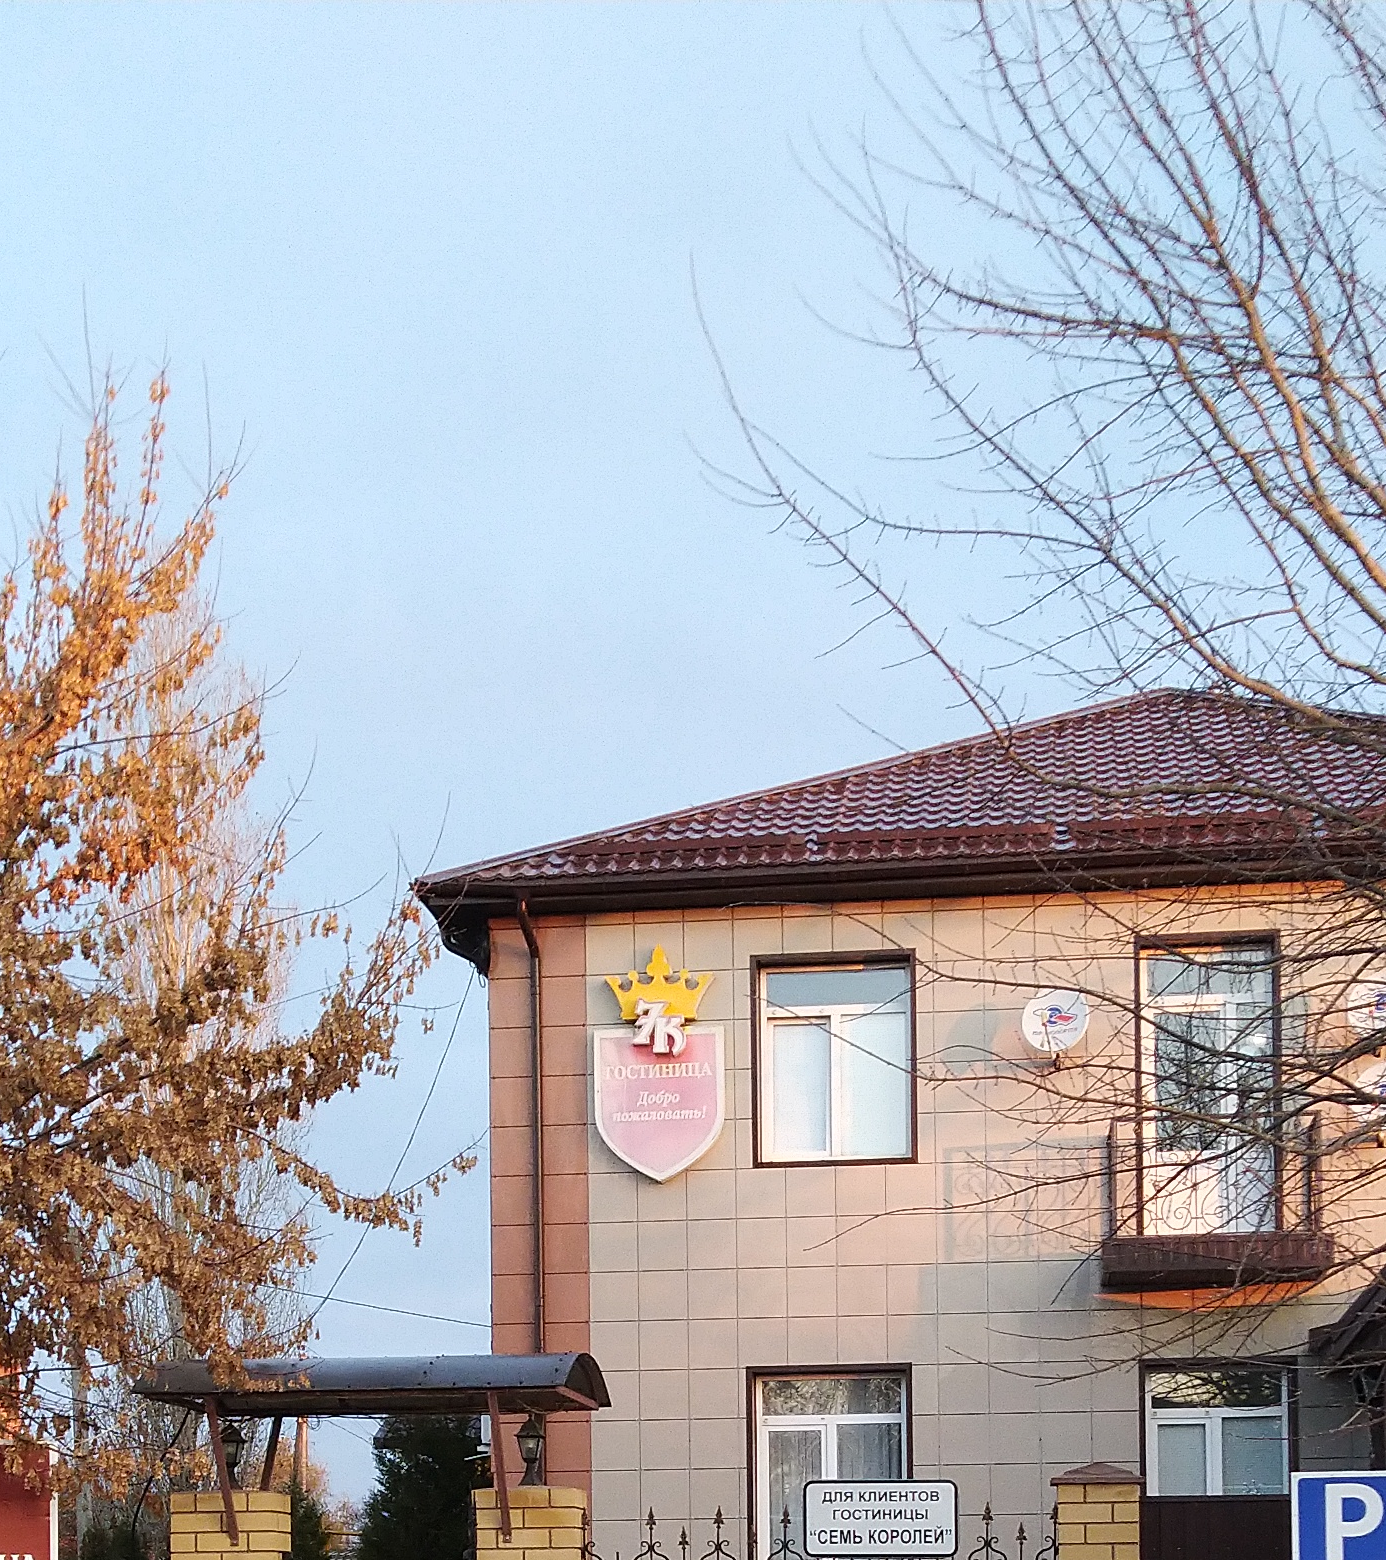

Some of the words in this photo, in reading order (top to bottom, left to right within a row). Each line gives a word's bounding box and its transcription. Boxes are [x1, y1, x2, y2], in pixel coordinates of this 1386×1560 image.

[606, 1062, 712, 1080] ГОСТИНИЦА
[637, 1091, 680, 1108] Добро
[613, 1106, 707, 1122] пожаловать!
[822, 1491, 853, 1504] ДЛЯ
[858, 1491, 940, 1502] КЛИЕНТОВ
[832, 1509, 929, 1522] ГОСТИНИЦЫ
